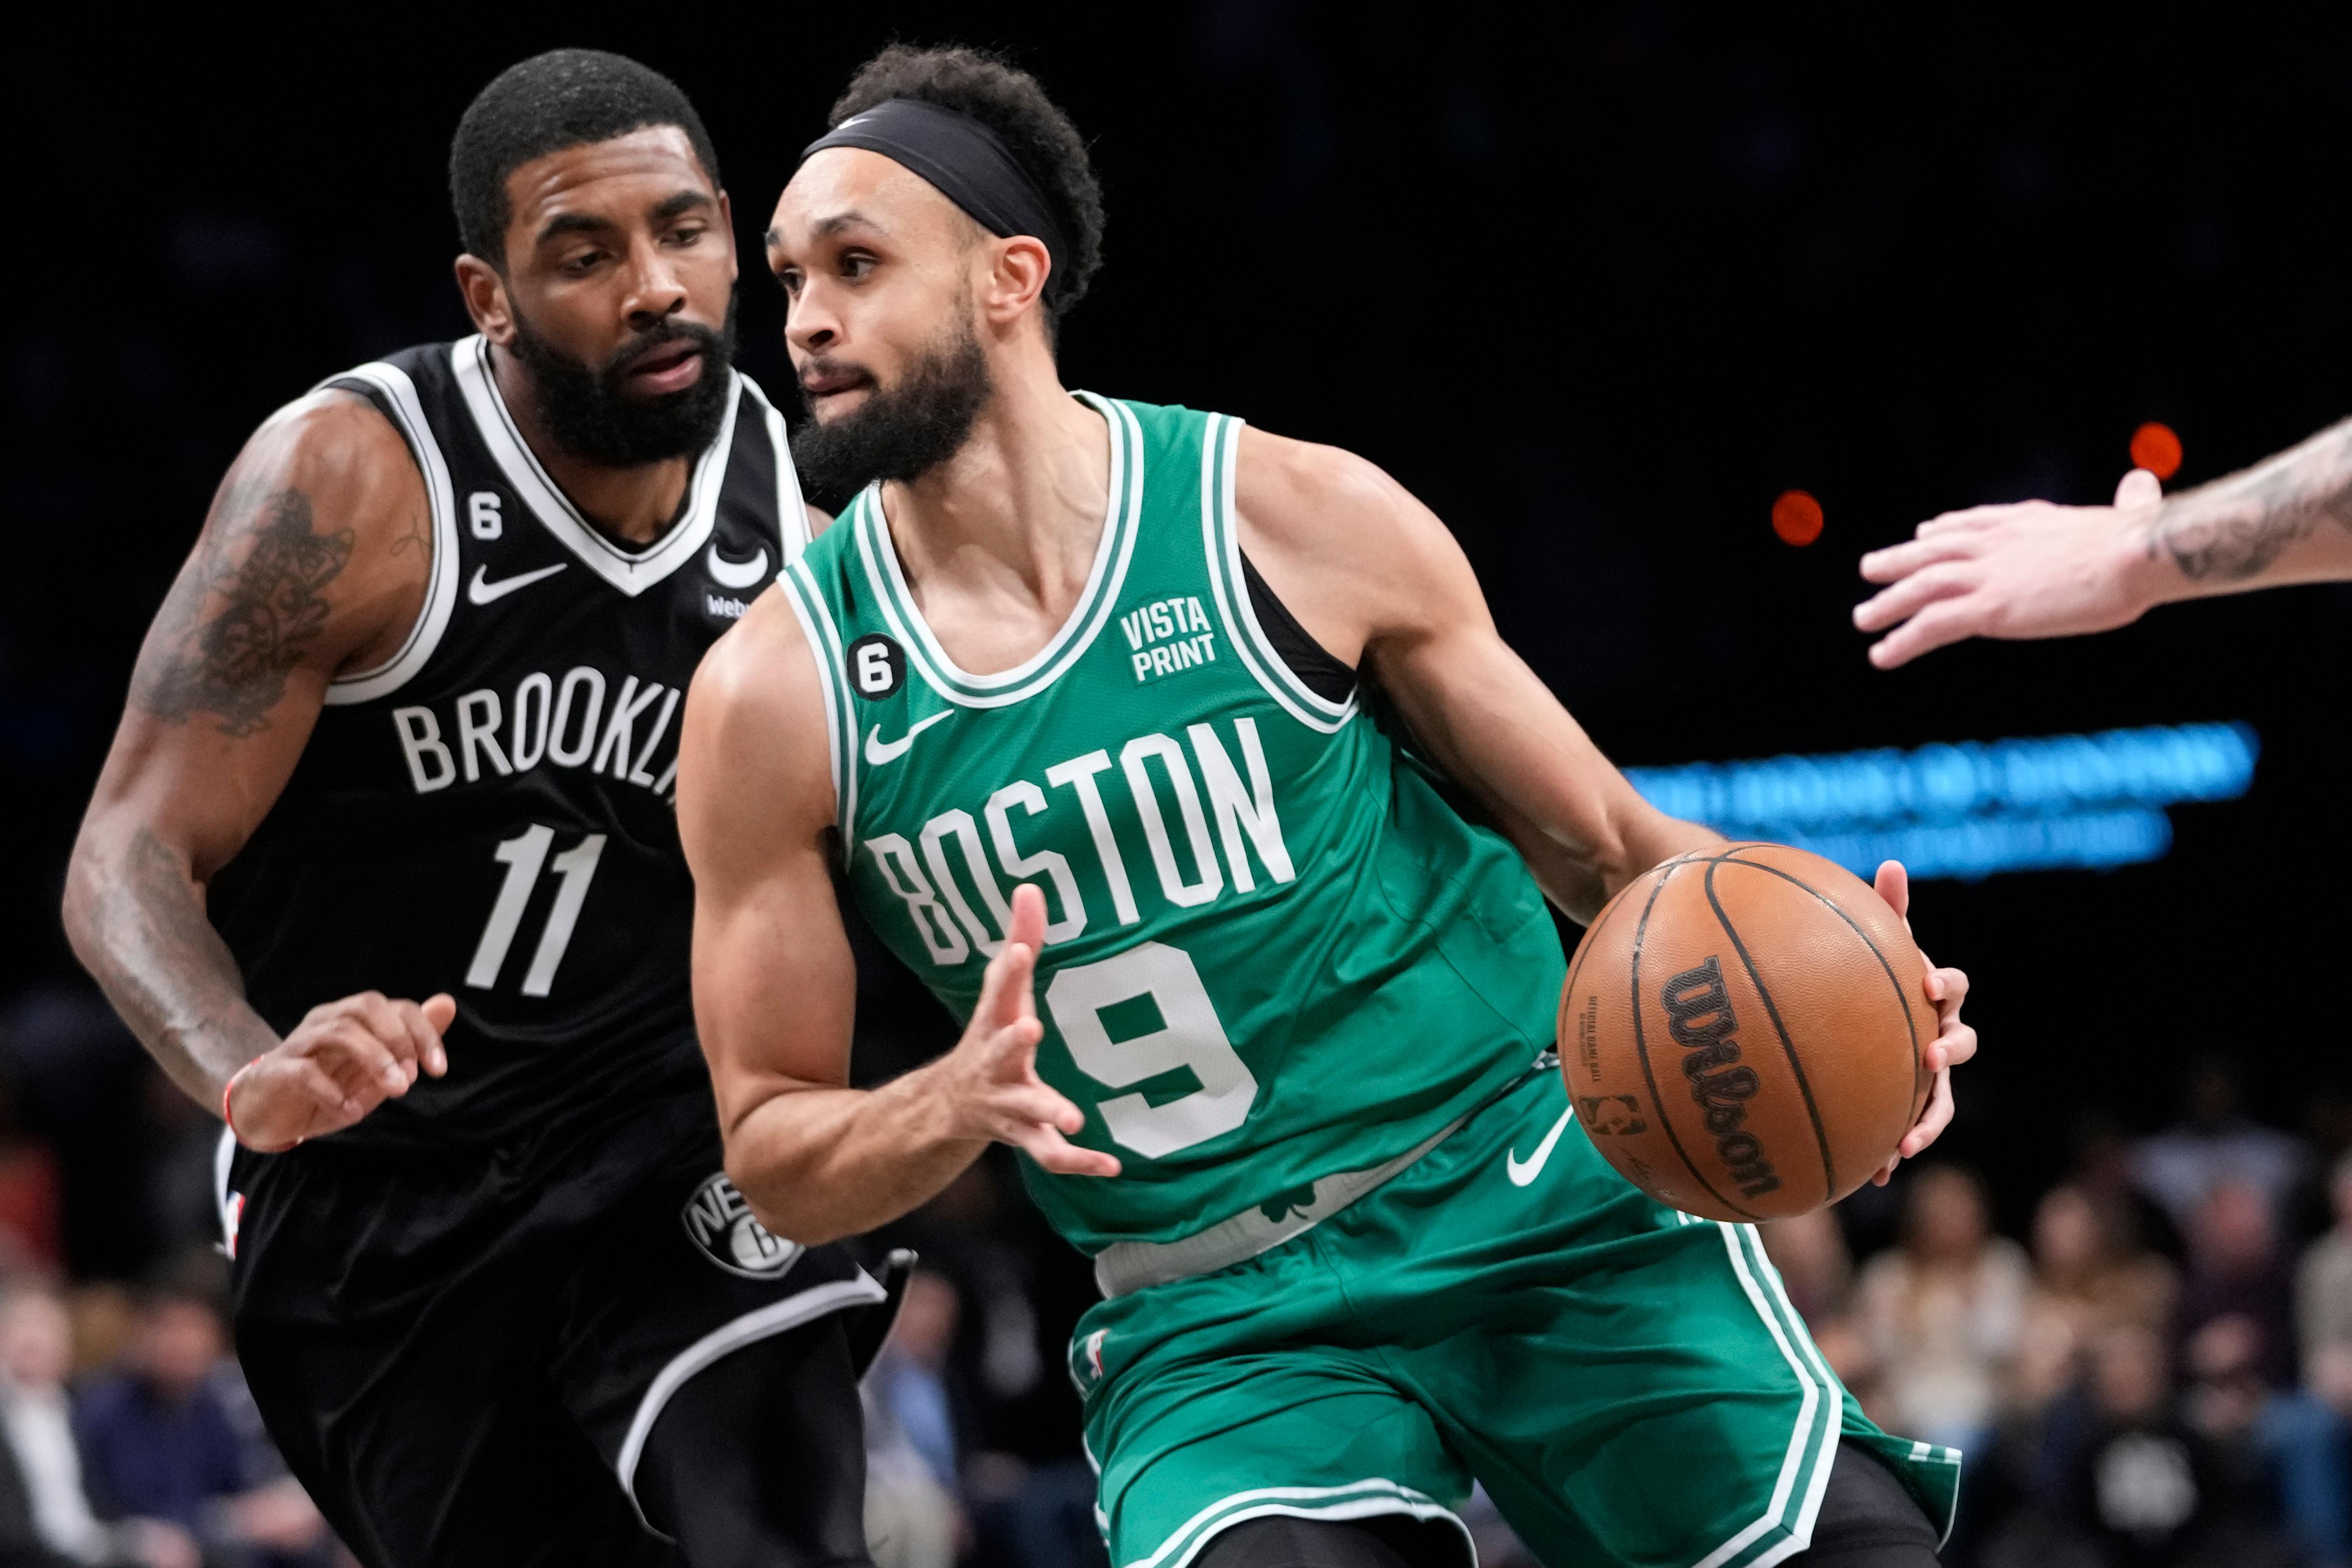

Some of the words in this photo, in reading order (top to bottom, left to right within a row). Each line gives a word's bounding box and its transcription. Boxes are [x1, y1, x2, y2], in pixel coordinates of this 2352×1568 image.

[469, 491, 503, 540] 6
[707, 594, 750, 617] Web
[1120, 597, 1211, 651] VISTA
[856, 642, 892, 693] 6
[1132, 632, 1216, 681] PRINT
[391, 665, 680, 806] BROOKL
[864, 718, 1295, 965] BOSTON
[465, 823, 607, 997] 11
[1045, 941, 1259, 1159] 9
[1661, 955, 1781, 1199] Wilson
[690, 1177, 750, 1247] NE
